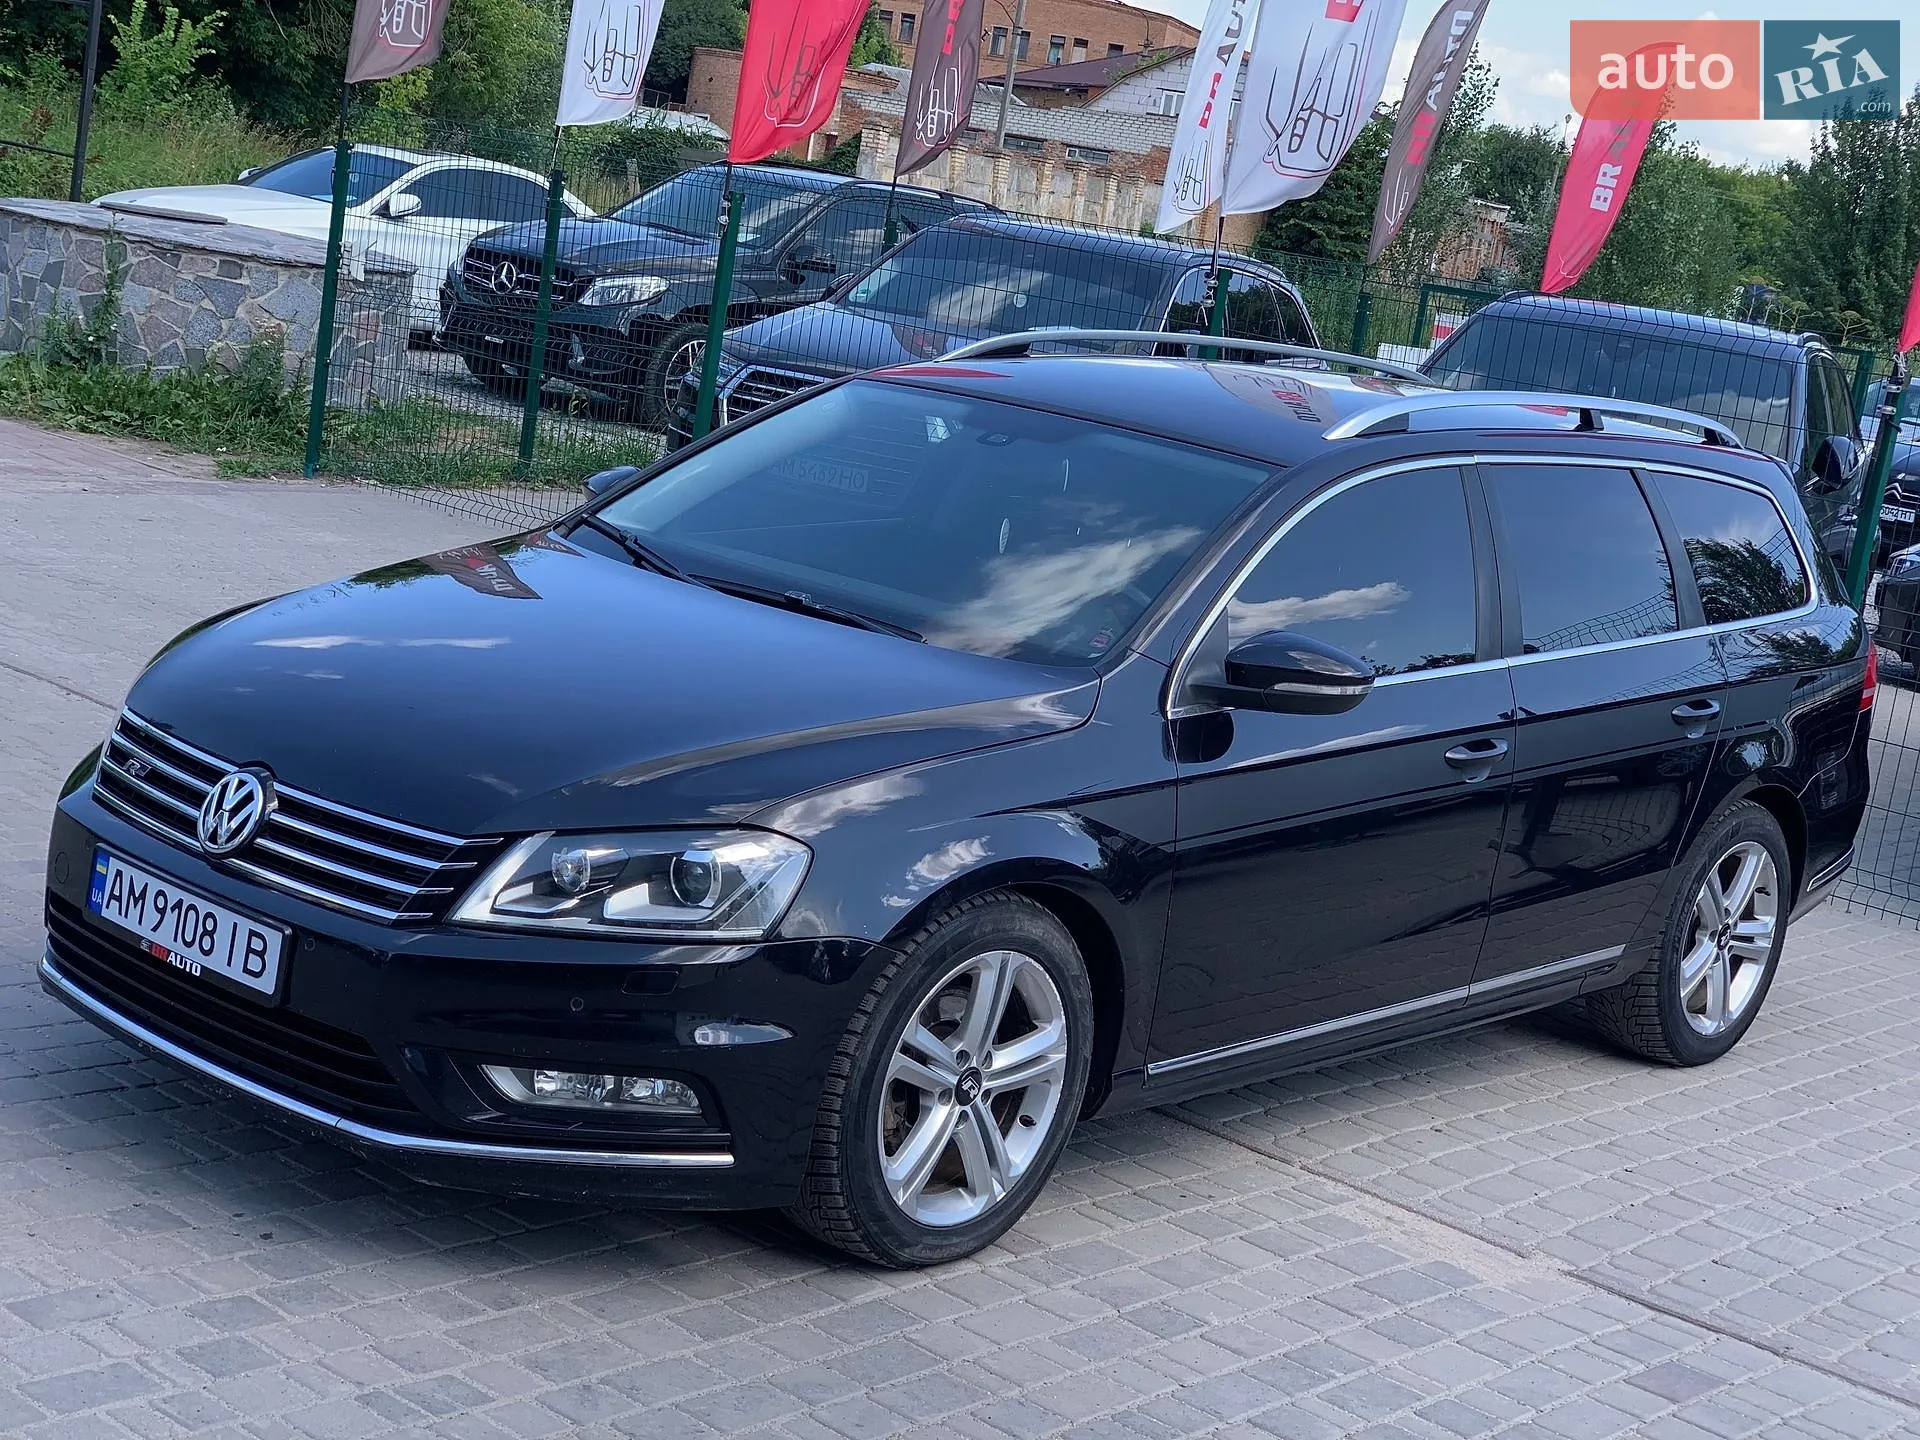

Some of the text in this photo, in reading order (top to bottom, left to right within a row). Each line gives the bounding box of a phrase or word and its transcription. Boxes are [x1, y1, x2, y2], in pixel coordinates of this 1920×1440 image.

[91, 888, 102, 905] UA
[105, 868, 268, 979] AM 9108 IB
